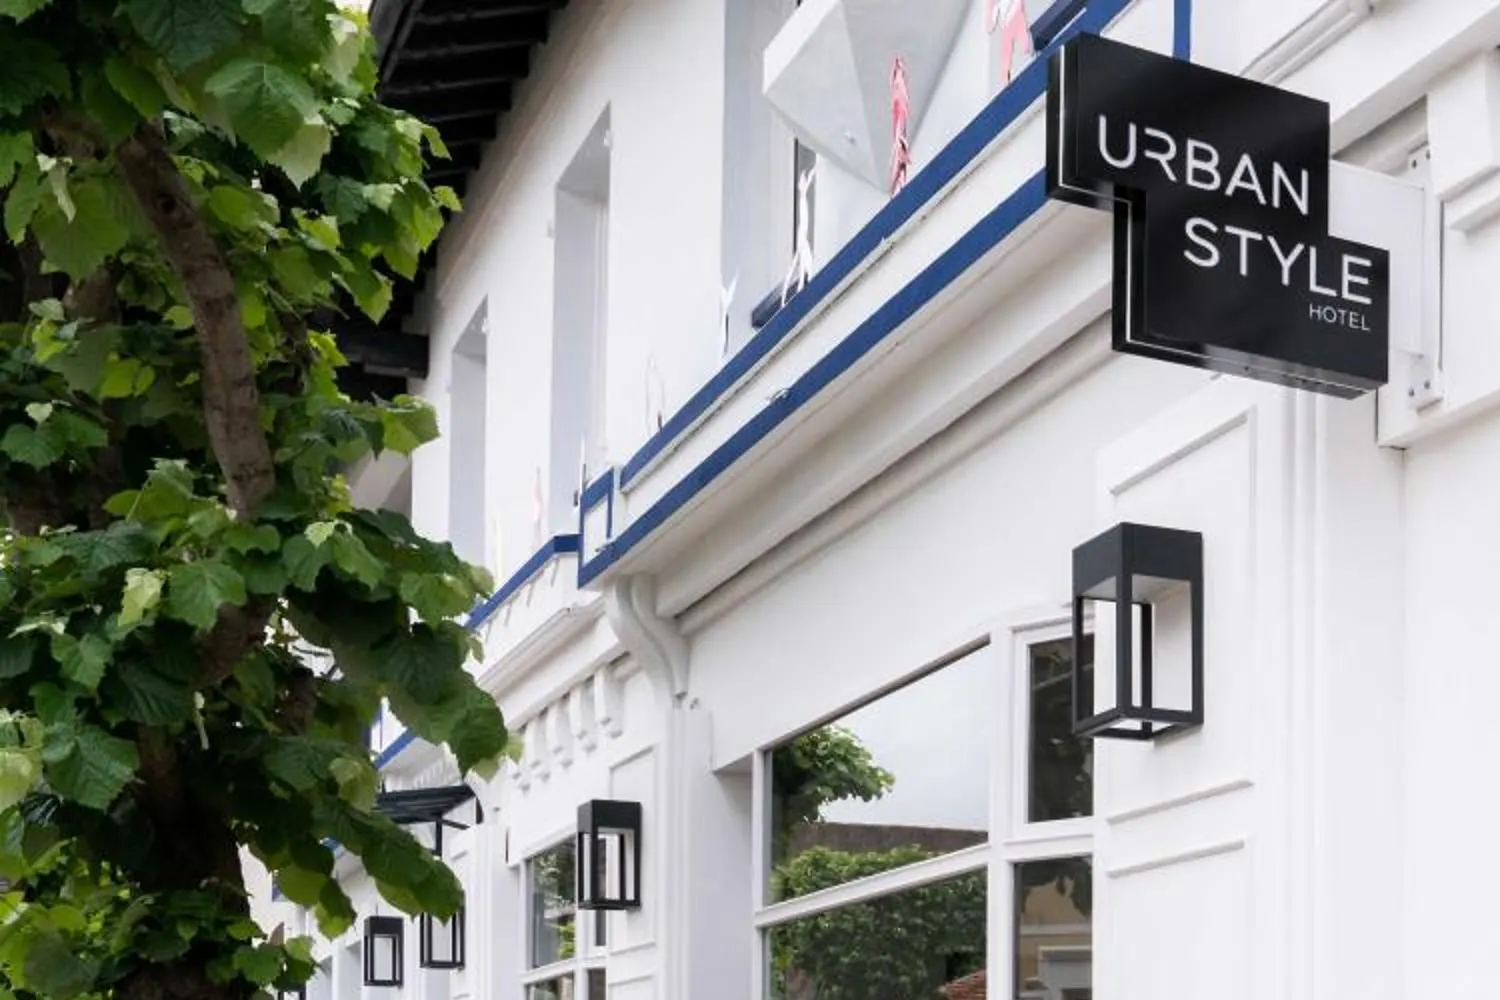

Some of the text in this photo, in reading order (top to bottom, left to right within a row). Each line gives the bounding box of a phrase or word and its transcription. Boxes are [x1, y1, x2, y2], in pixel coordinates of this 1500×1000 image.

[1098, 115, 1309, 216] URBAN
[1183, 217, 1372, 304] STYLE
[1308, 304, 1370, 332] HOTEL
